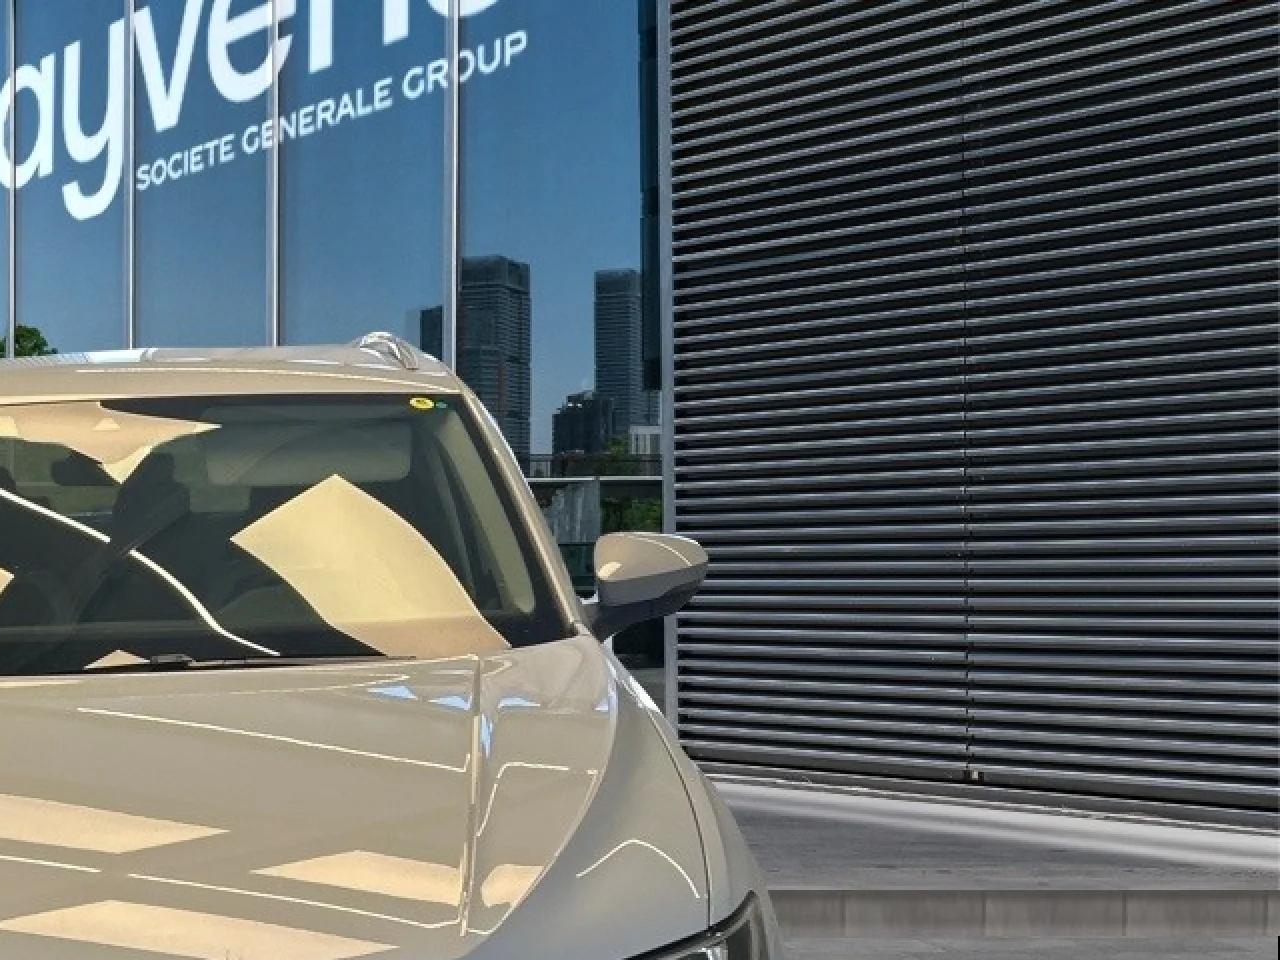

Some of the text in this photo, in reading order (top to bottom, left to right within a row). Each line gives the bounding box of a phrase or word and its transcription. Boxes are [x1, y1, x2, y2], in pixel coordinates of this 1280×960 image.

[136, 30, 528, 191] SOCIETE GENERALE GROUP
